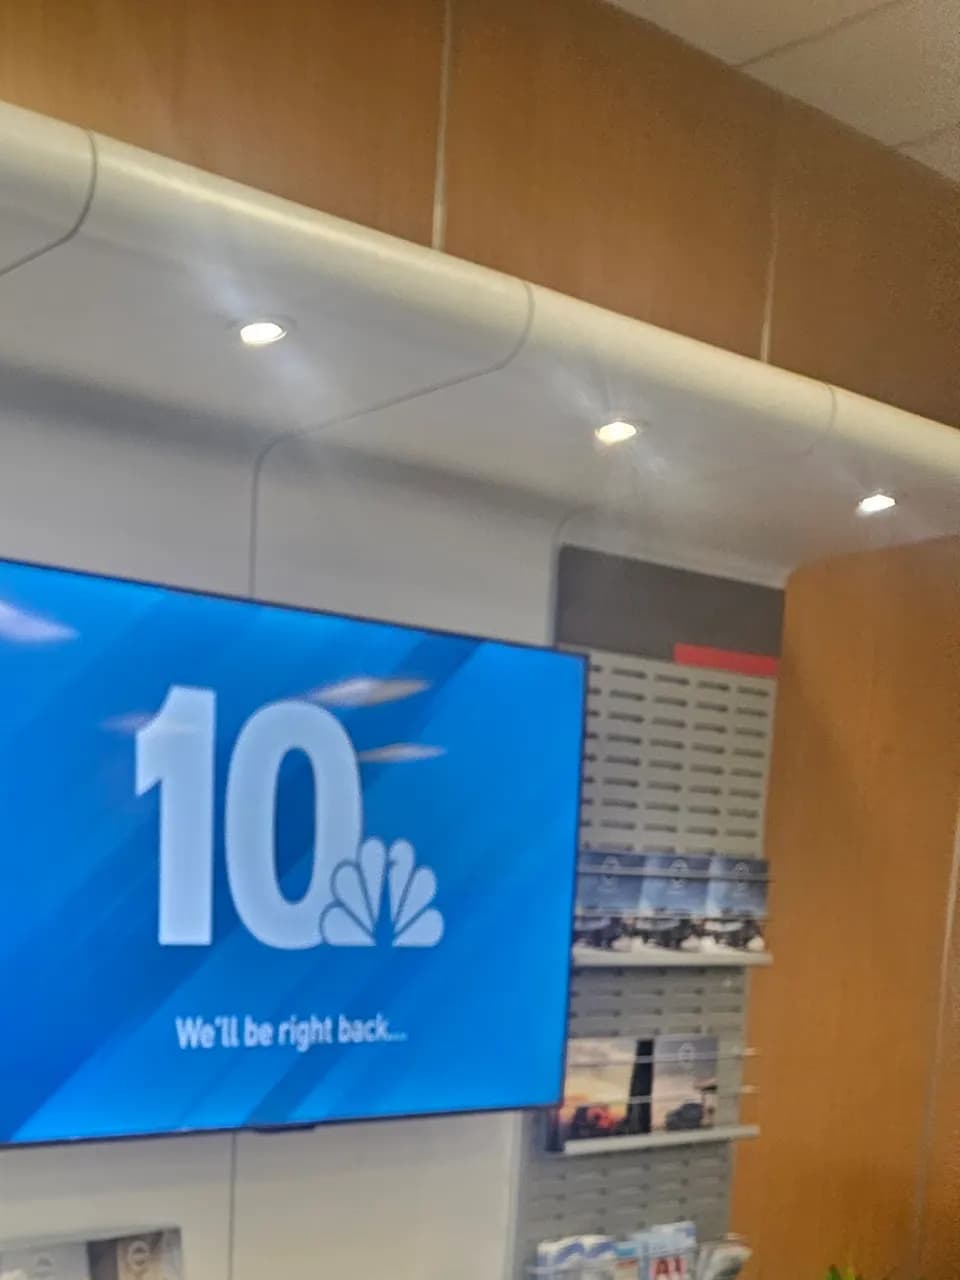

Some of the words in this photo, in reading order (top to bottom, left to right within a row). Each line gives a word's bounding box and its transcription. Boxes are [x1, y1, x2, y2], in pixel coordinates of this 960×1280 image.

[135, 684, 363, 950] 10
[175, 1014, 240, 1049] We'll
[244, 1014, 274, 1047] be
[278, 1013, 333, 1053] right
